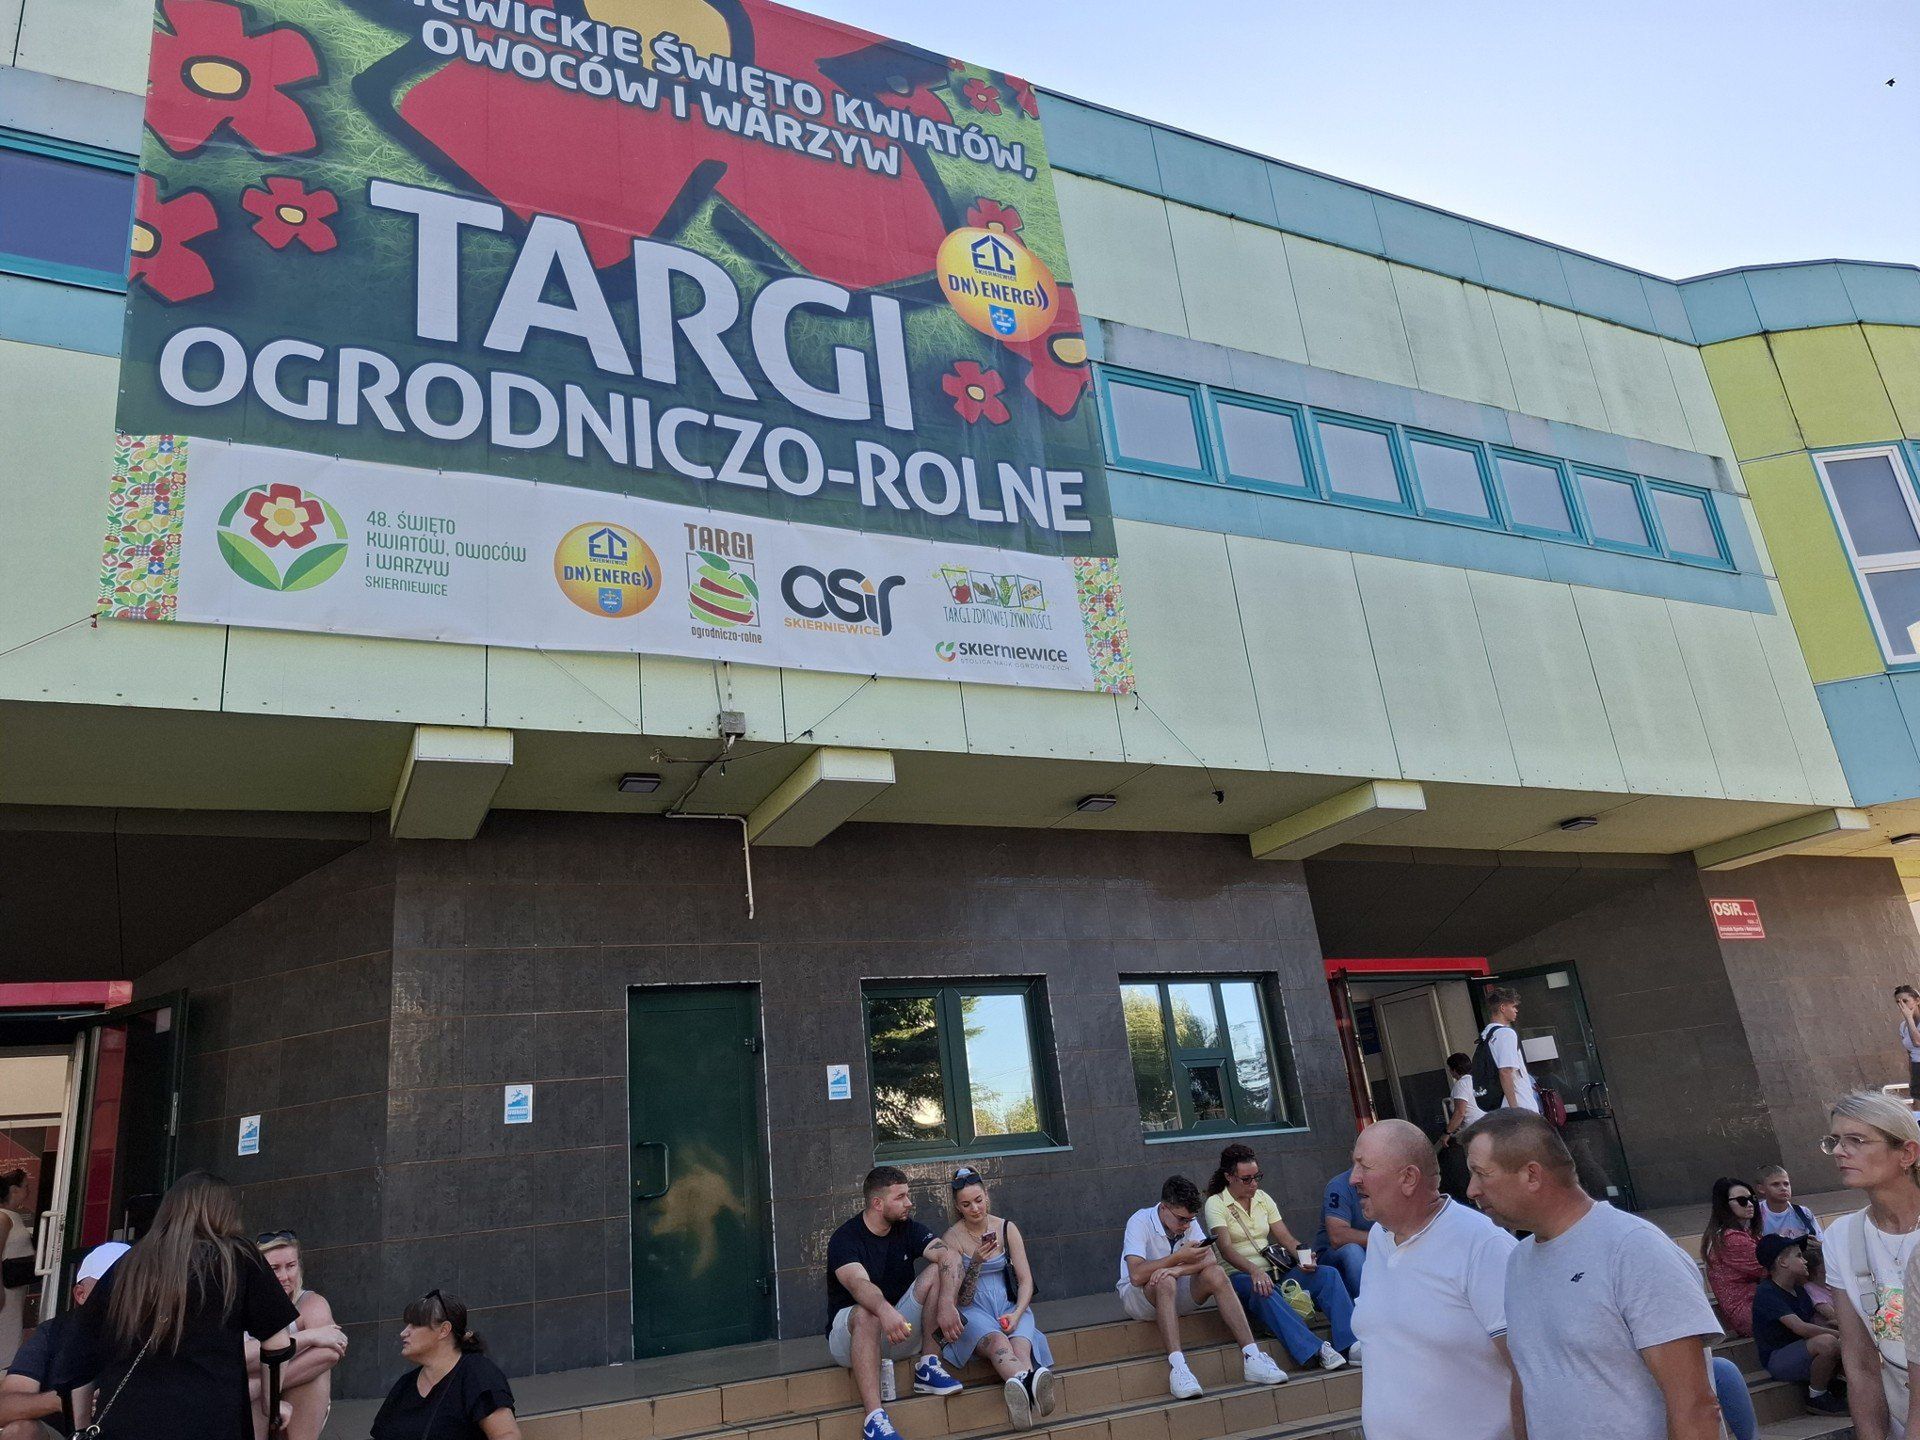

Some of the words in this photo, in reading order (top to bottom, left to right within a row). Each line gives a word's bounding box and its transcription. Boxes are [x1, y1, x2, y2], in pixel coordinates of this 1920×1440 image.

[422, 20, 659, 109] OWOCÓW
[673, 85, 686, 118] I
[701, 91, 899, 176] WARZYW
[654, 35, 822, 116] ŚWIĘTO
[835, 93, 1034, 179] KWIATÓW,
[370, 179, 914, 431] TARGI
[159, 325, 1092, 533] OGRODNICZO-ROLNE
[366, 510, 391, 528] 48.
[397, 510, 456, 537] ŚWIĘTO
[366, 531, 450, 557] KWIATÓW,
[455, 541, 527, 563] OWOCÓW
[684, 522, 755, 560] TARGI
[376, 553, 450, 577] WARZYW
[365, 575, 448, 597] SKIERNIEWICE
[783, 616, 881, 637] SKIERNIEWICE
[943, 606, 971, 624] TARGI
[972, 608, 1008, 629] ZDROWEJ
[691, 625, 763, 644] ogrodniczo-rolne
[1329, 1192, 1340, 1209] 3
